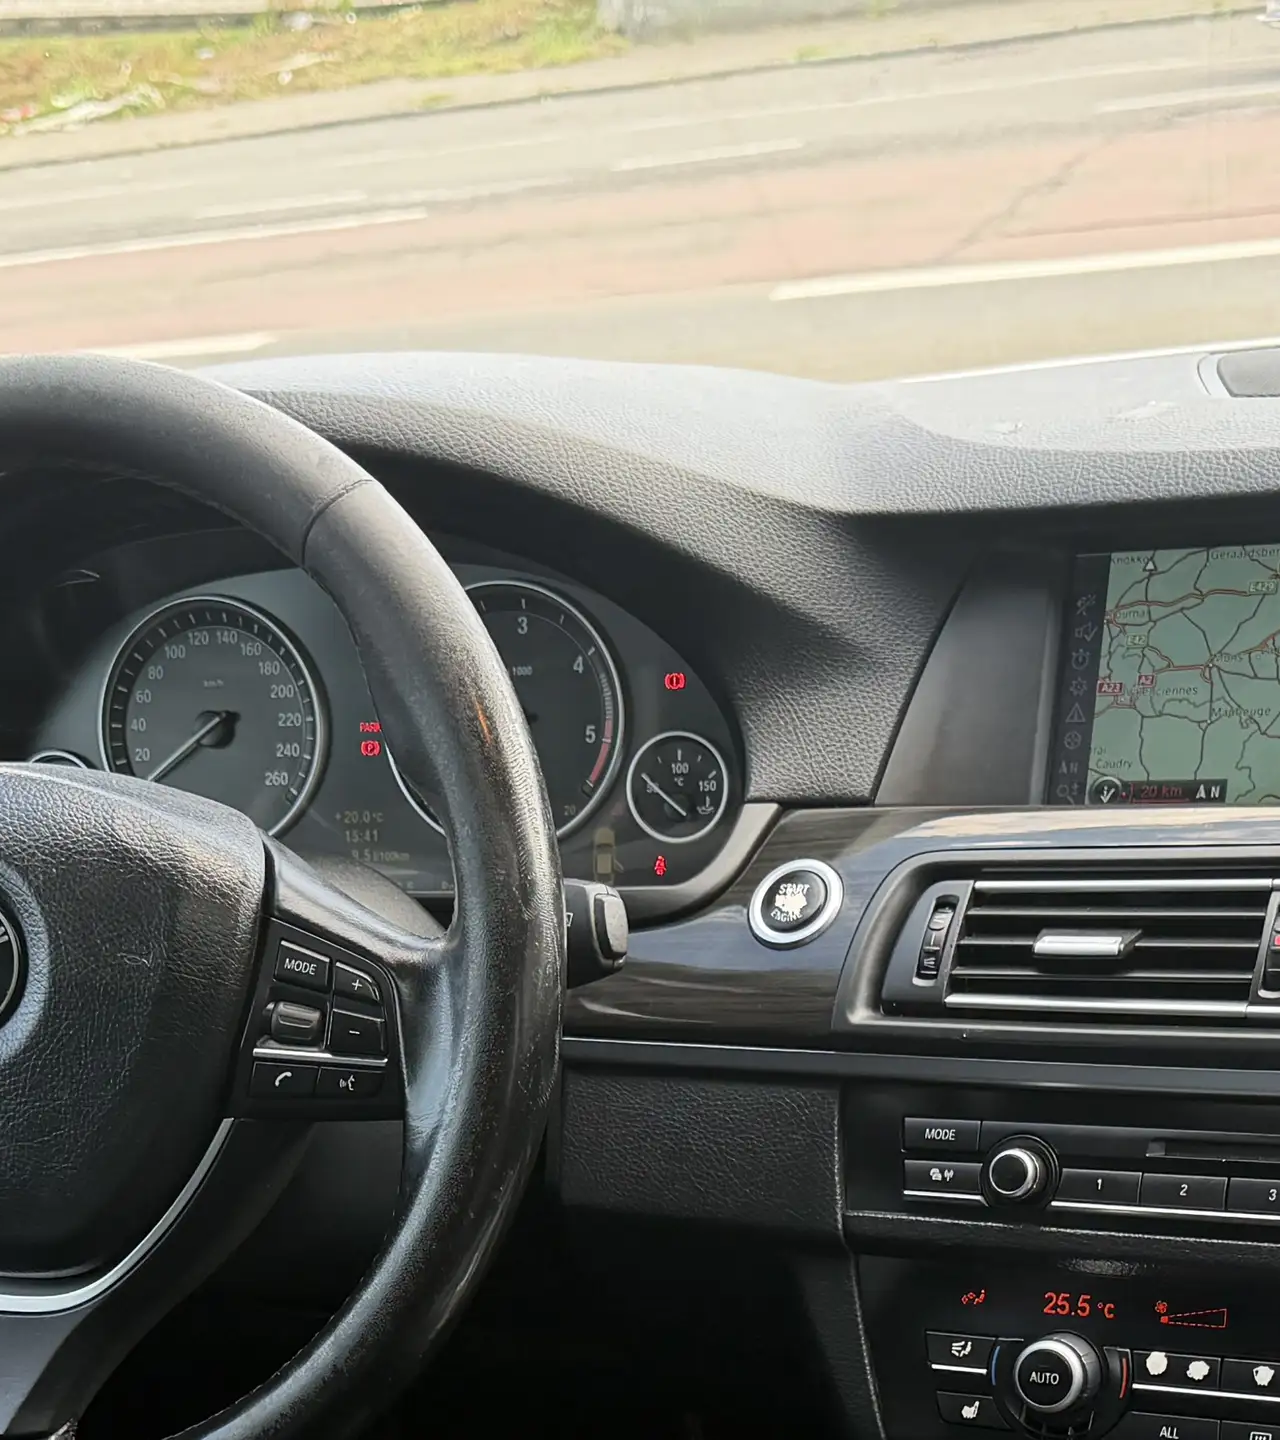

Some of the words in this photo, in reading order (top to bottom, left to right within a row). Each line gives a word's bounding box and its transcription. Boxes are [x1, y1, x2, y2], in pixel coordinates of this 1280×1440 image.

[1250, 582, 1275, 593] E429
[517, 617, 528, 635] 3
[188, 631, 210, 646] 120
[216, 631, 238, 645] 140
[1128, 635, 1146, 646] E42
[165, 645, 186, 660] 100
[240, 642, 262, 656] 160
[258, 661, 280, 676] 180
[573, 655, 584, 674] 4
[147, 666, 164, 680] 80
[1140, 675, 1153, 686] A2
[270, 684, 295, 699] 200
[1101, 683, 1121, 693] A23
[1122, 685, 1199, 697] Veciennes
[135, 690, 152, 704] 60
[130, 718, 147, 732] 40
[278, 713, 302, 727] 220
[585, 725, 596, 744] 5
[135, 748, 151, 762] 20
[276, 743, 300, 758] 240
[671, 762, 690, 774] 100
[1096, 759, 1133, 771] Caudry
[265, 772, 289, 786] 260
[699, 781, 717, 792] 150
[1140, 785, 1158, 798] 20
[1161, 785, 1183, 798] km
[345, 830, 379, 843] 15:41
[779, 882, 811, 897] START
[283, 957, 317, 976] MODE
[924, 1127, 956, 1141] MODE
[1096, 1178, 1103, 1190] 1
[1179, 1184, 1189, 1196] 2
[1269, 1188, 1277, 1201] 3
[1043, 1291, 1091, 1317] 25.5
[1029, 1371, 1059, 1386] AUTO
[1159, 1425, 1179, 1440] ALL
